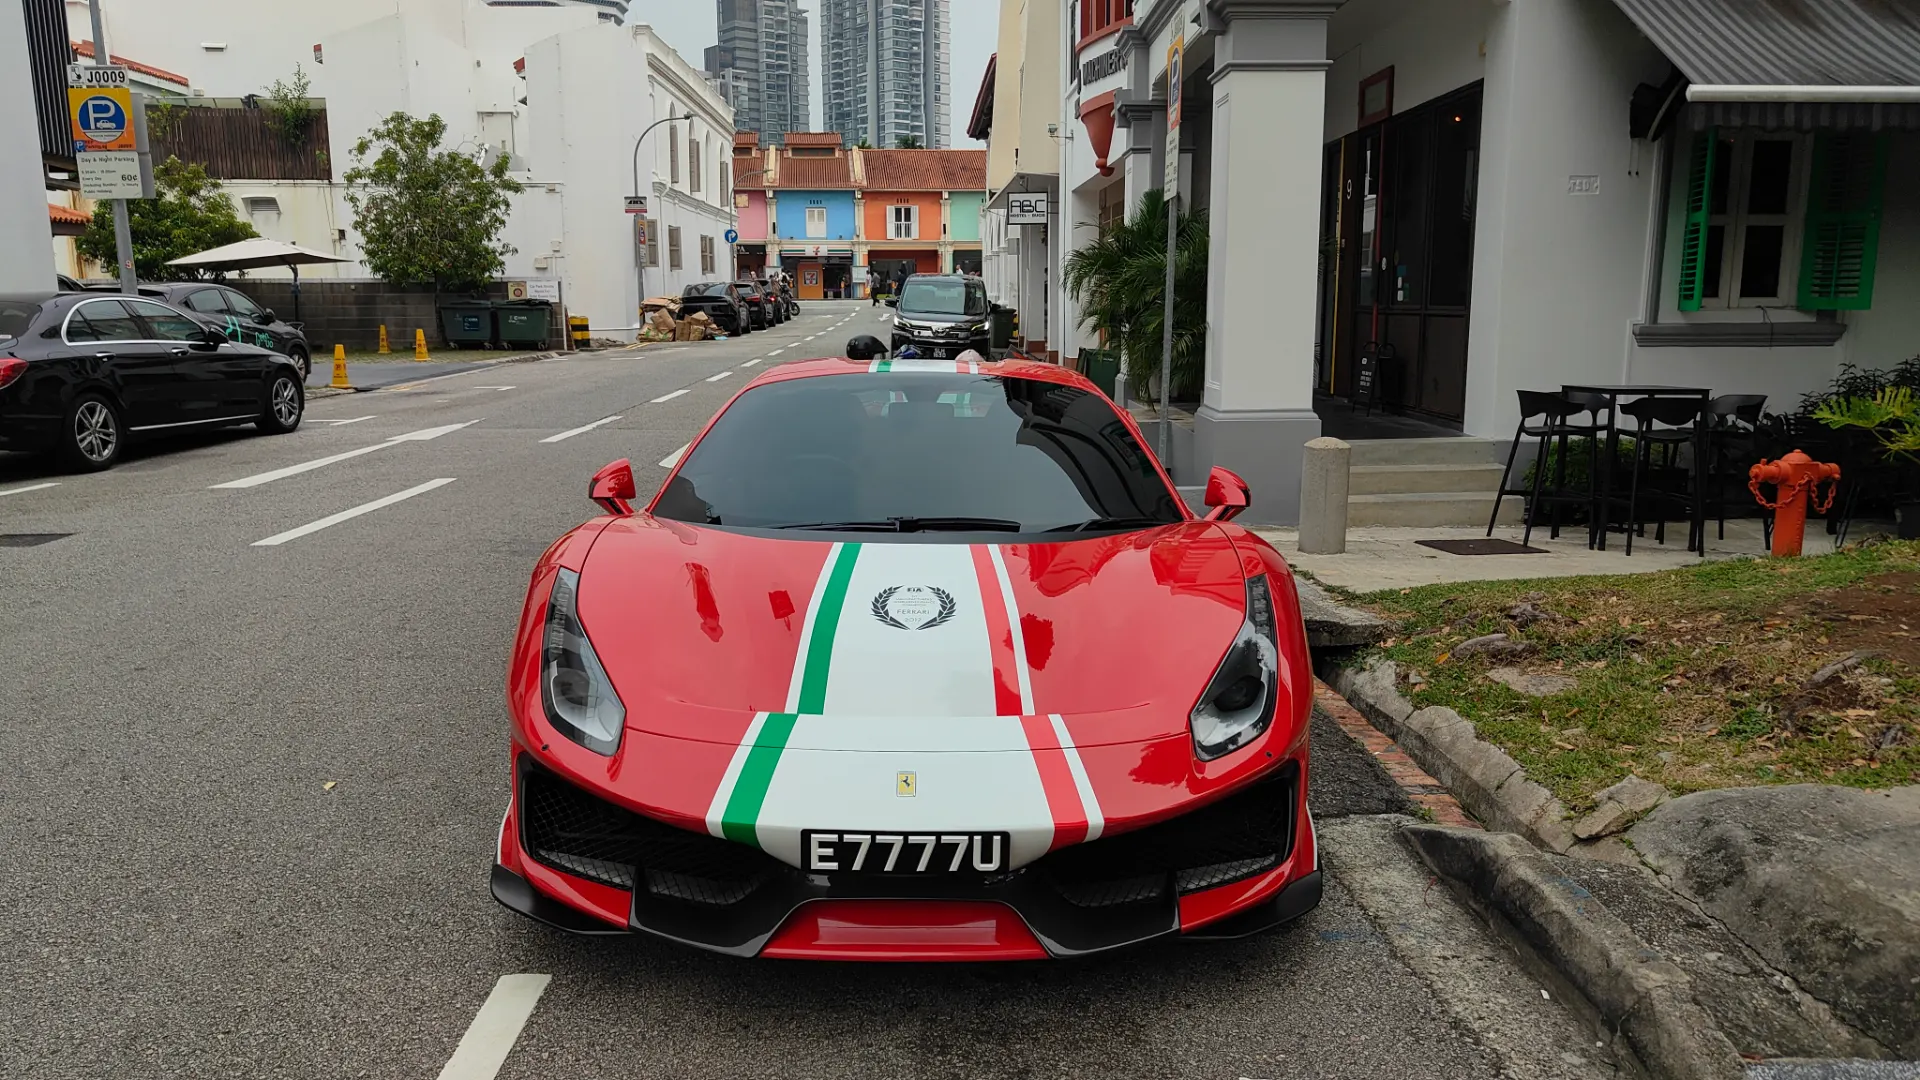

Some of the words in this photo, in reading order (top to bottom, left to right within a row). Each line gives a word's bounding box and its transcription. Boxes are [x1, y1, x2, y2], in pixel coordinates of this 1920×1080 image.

[87, 71, 126, 83] J0009
[87, 99, 116, 130] P
[99, 155, 112, 163] Night
[1346, 179, 1352, 200] 9
[1010, 200, 1046, 213] ABC
[810, 833, 1002, 872] E7777U
